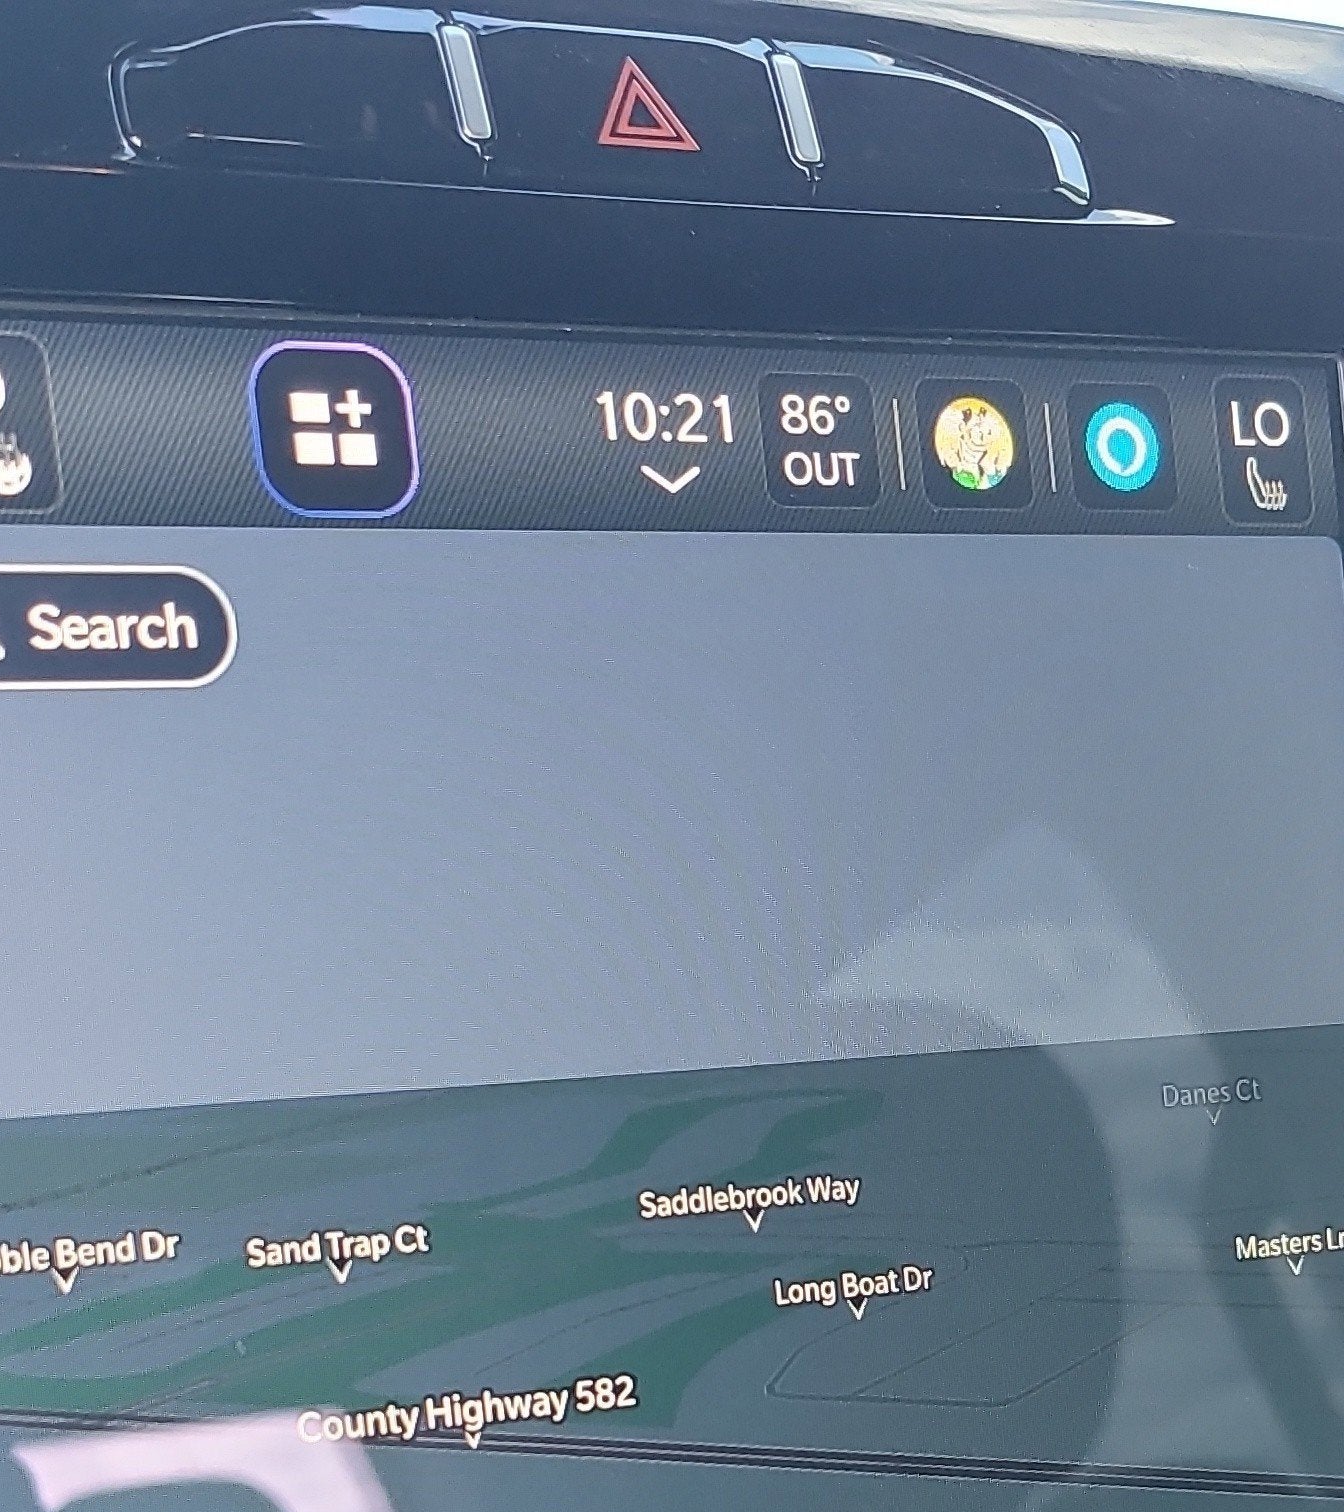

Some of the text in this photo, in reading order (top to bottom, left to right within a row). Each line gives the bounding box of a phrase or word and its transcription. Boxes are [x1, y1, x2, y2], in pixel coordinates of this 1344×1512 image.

[596, 388, 736, 445] 10:21
[779, 393, 852, 437] 86°
[1230, 400, 1290, 448] LO
[783, 451, 861, 489] OUT
[26, 601, 199, 653] Search
[1162, 1078, 1261, 1109] Danes Ct
[639, 1176, 861, 1219] Saddlebrook Way
[55, 1231, 137, 1270] Bend
[141, 1229, 180, 1262] Dr
[246, 1224, 429, 1270] Sand Trap Ct
[1234, 1229, 1322, 1261] Masters
[774, 1266, 934, 1308] Long Boat Dr
[296, 1375, 637, 1446] County Highway 582
